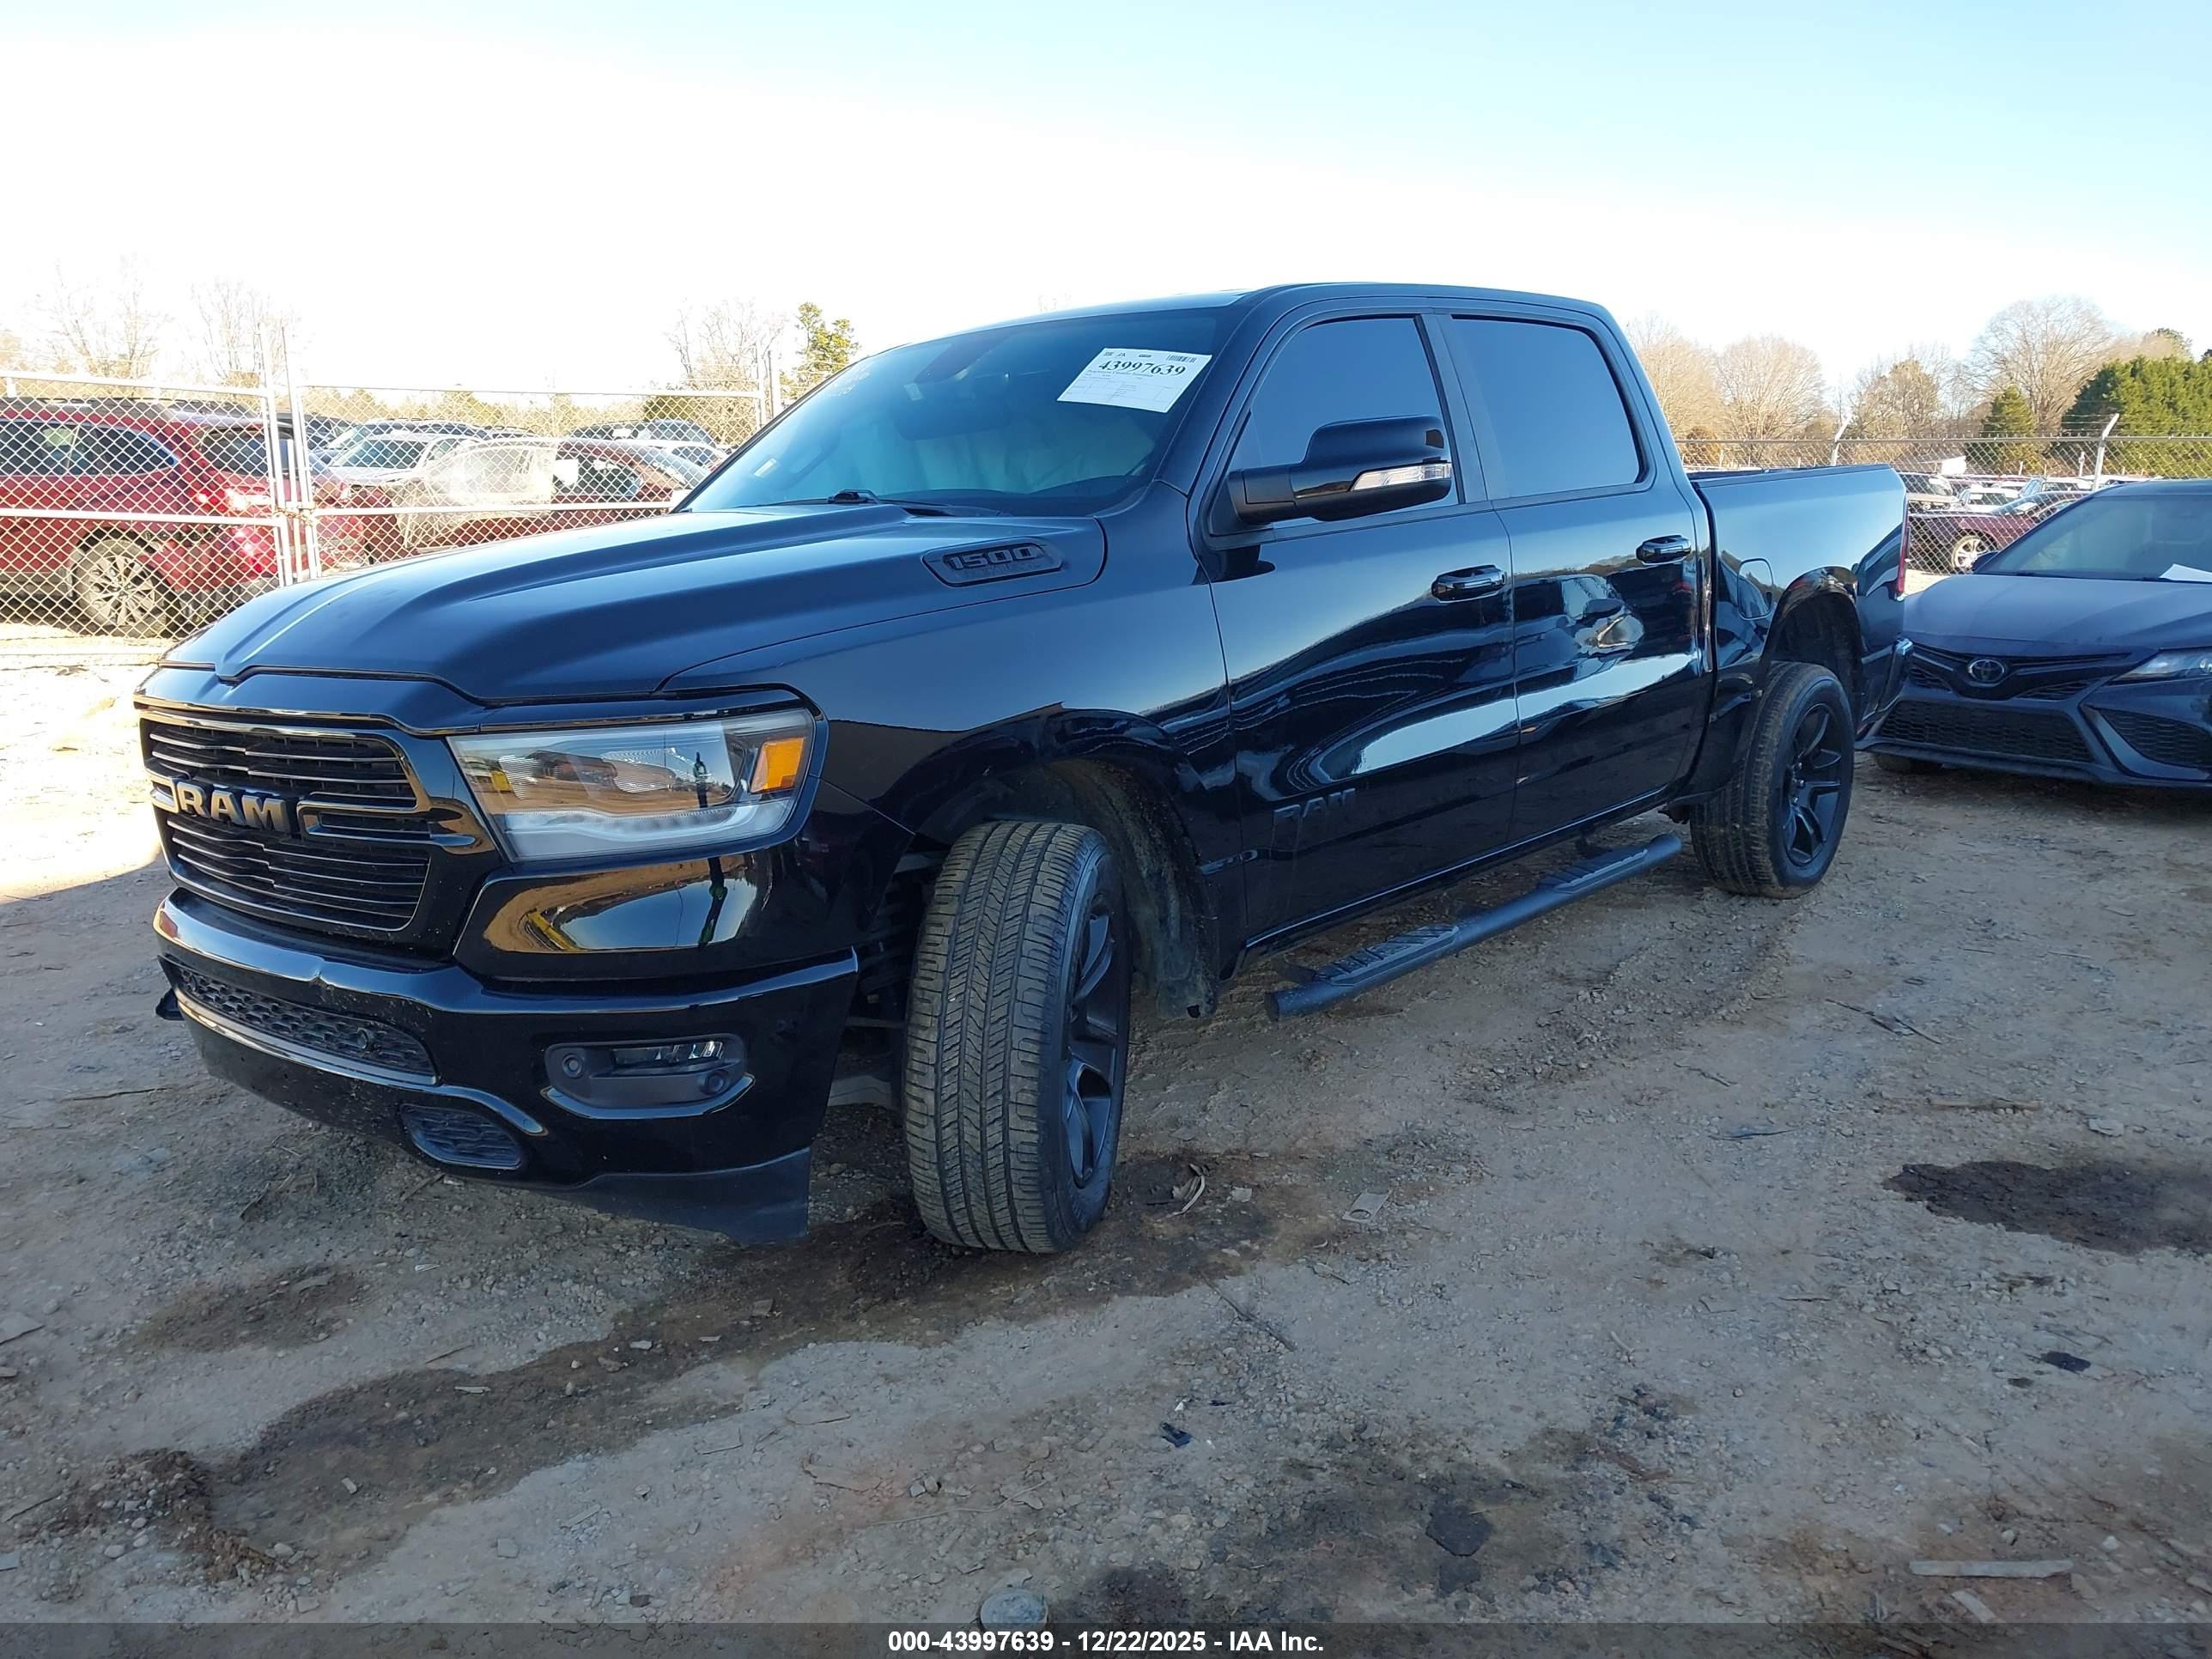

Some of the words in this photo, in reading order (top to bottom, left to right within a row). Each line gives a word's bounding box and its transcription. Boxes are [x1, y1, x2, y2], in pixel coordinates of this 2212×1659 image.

[1098, 360, 1187, 376] 43997639
[949, 546, 1038, 570] 1500
[177, 781, 291, 835] RAM
